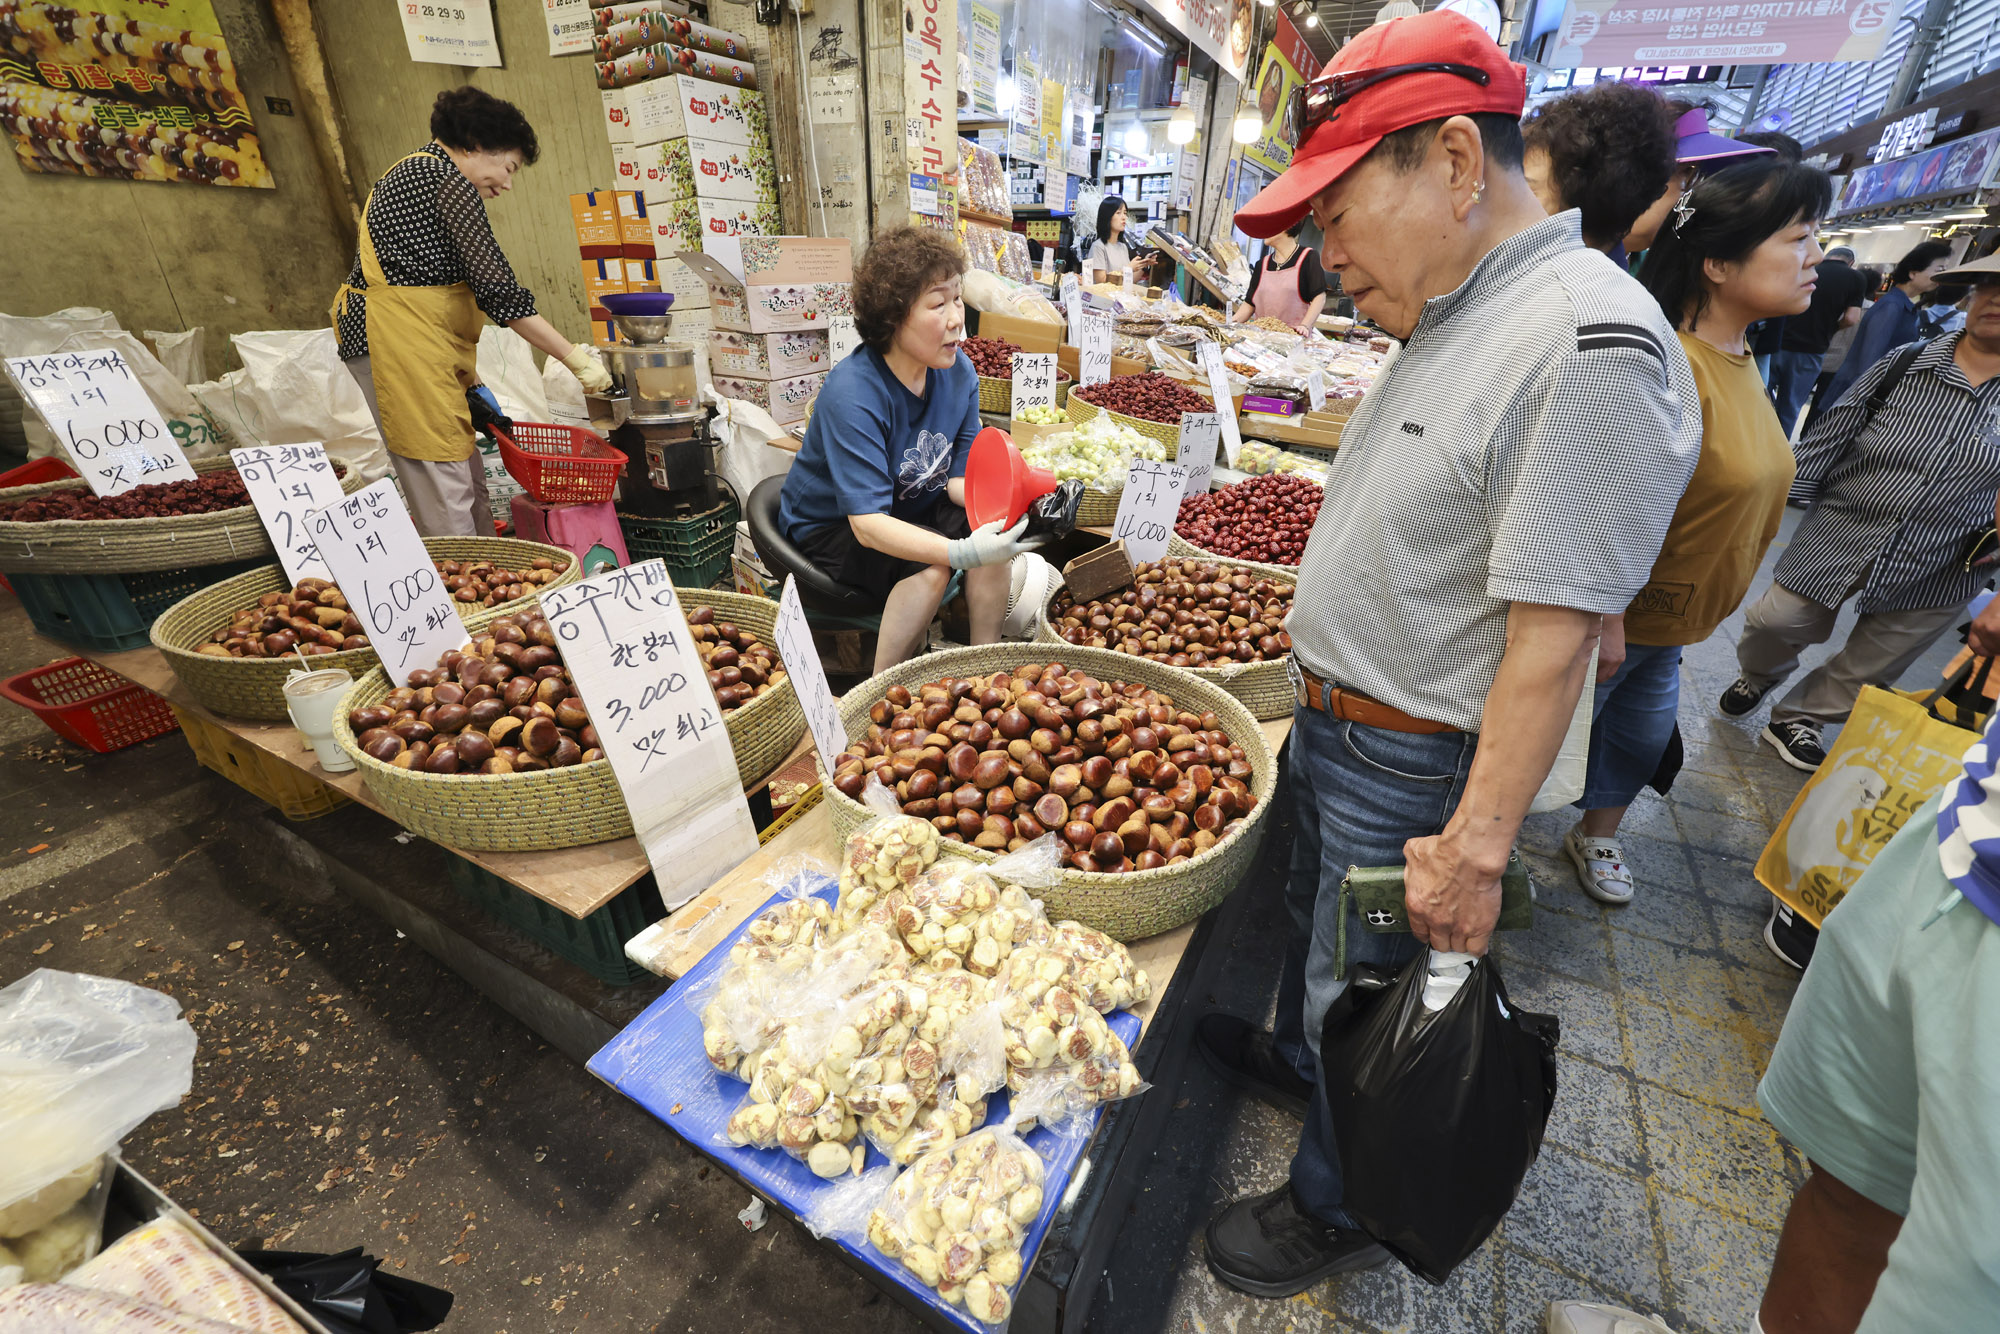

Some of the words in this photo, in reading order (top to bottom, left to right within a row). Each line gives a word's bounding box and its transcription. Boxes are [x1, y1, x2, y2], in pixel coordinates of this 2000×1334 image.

[407, 4, 417, 14] 27
[422, 6, 434, 16] 28
[437, 8, 449, 18] 29
[453, 10, 465, 20] 30
[70, 386, 108, 408] 1되
[1400, 421, 1425, 438] NEPA
[279, 481, 315, 503] 1되
[1134, 492, 1157, 508] 1되
[1117, 514, 1167, 543] 4.000
[354, 530, 388, 563] 1되
[363, 567, 435, 636] 6.000
[605, 672, 688, 733] 3.000
